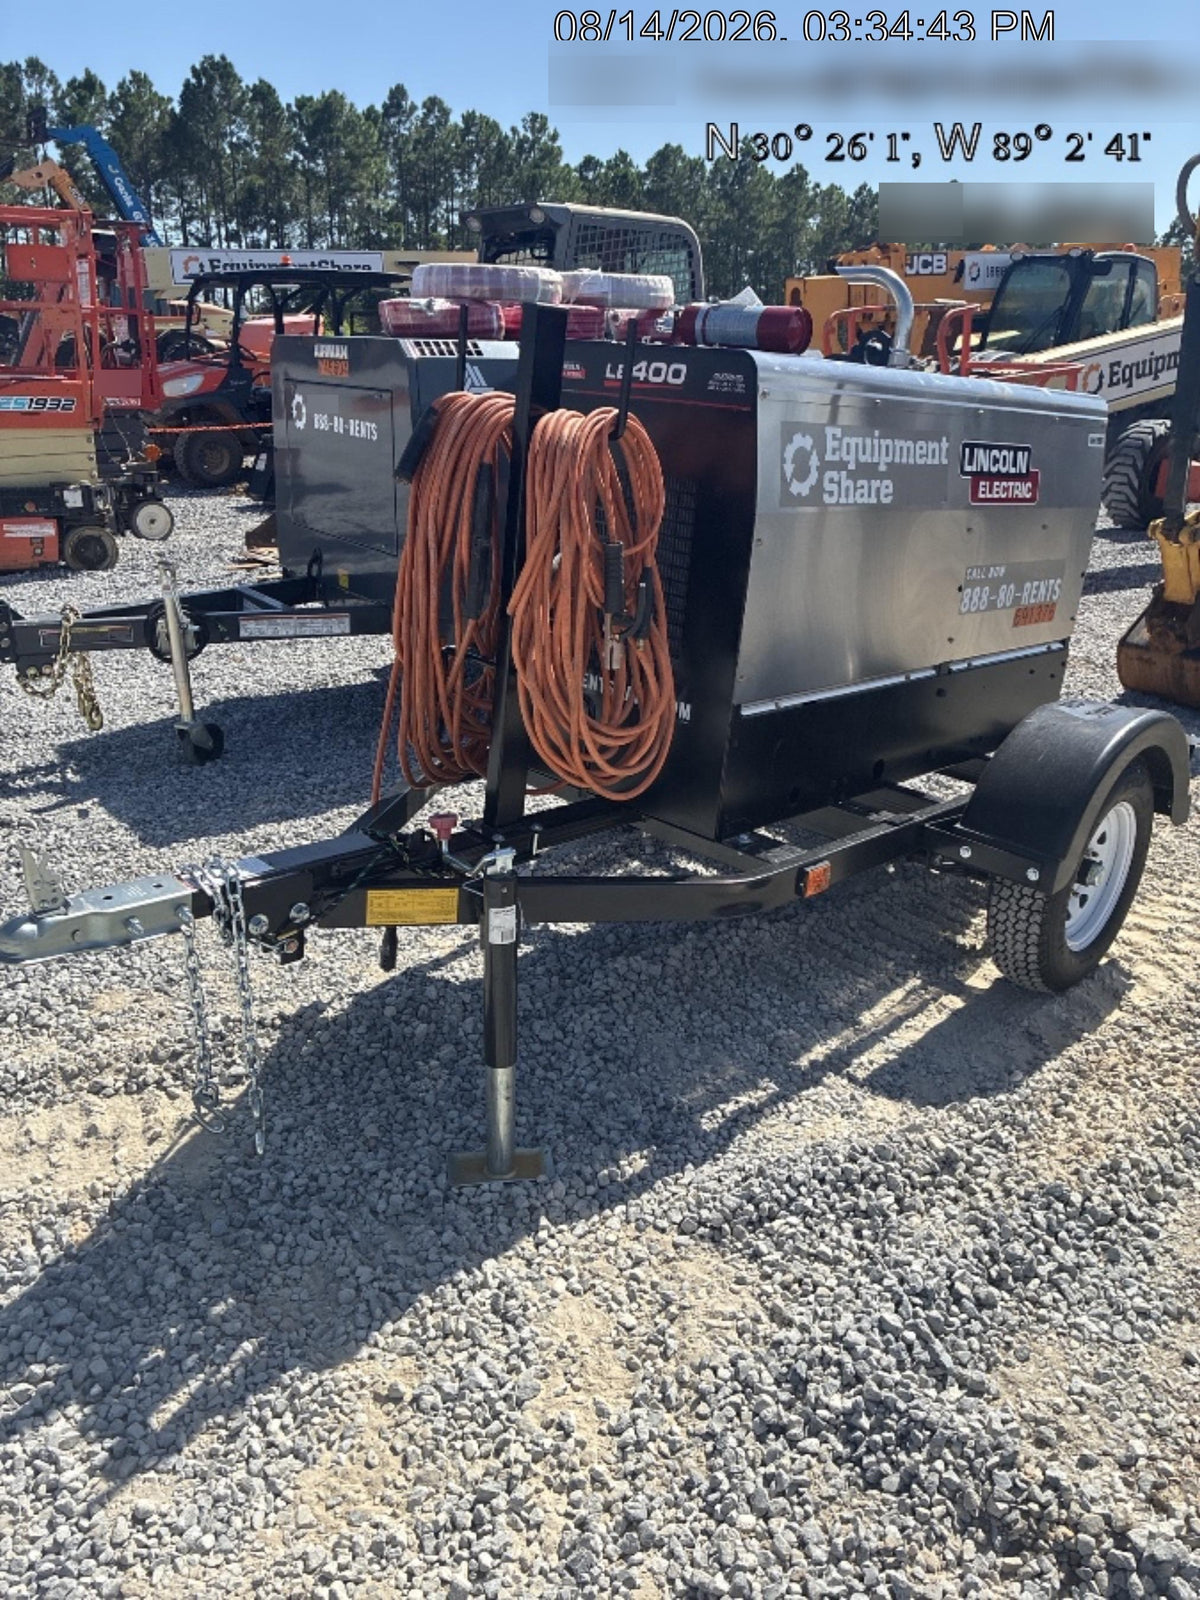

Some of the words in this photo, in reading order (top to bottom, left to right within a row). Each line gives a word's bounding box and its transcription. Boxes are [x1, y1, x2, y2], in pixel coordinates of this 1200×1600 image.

[906, 254, 947, 275] JCB
[823, 425, 949, 472] Equipment
[963, 446, 1030, 475] LINCOLN
[822, 470, 894, 505] Share
[977, 480, 1033, 500] ELECTRIC
[961, 578, 1061, 613] 888-80-RENTS
